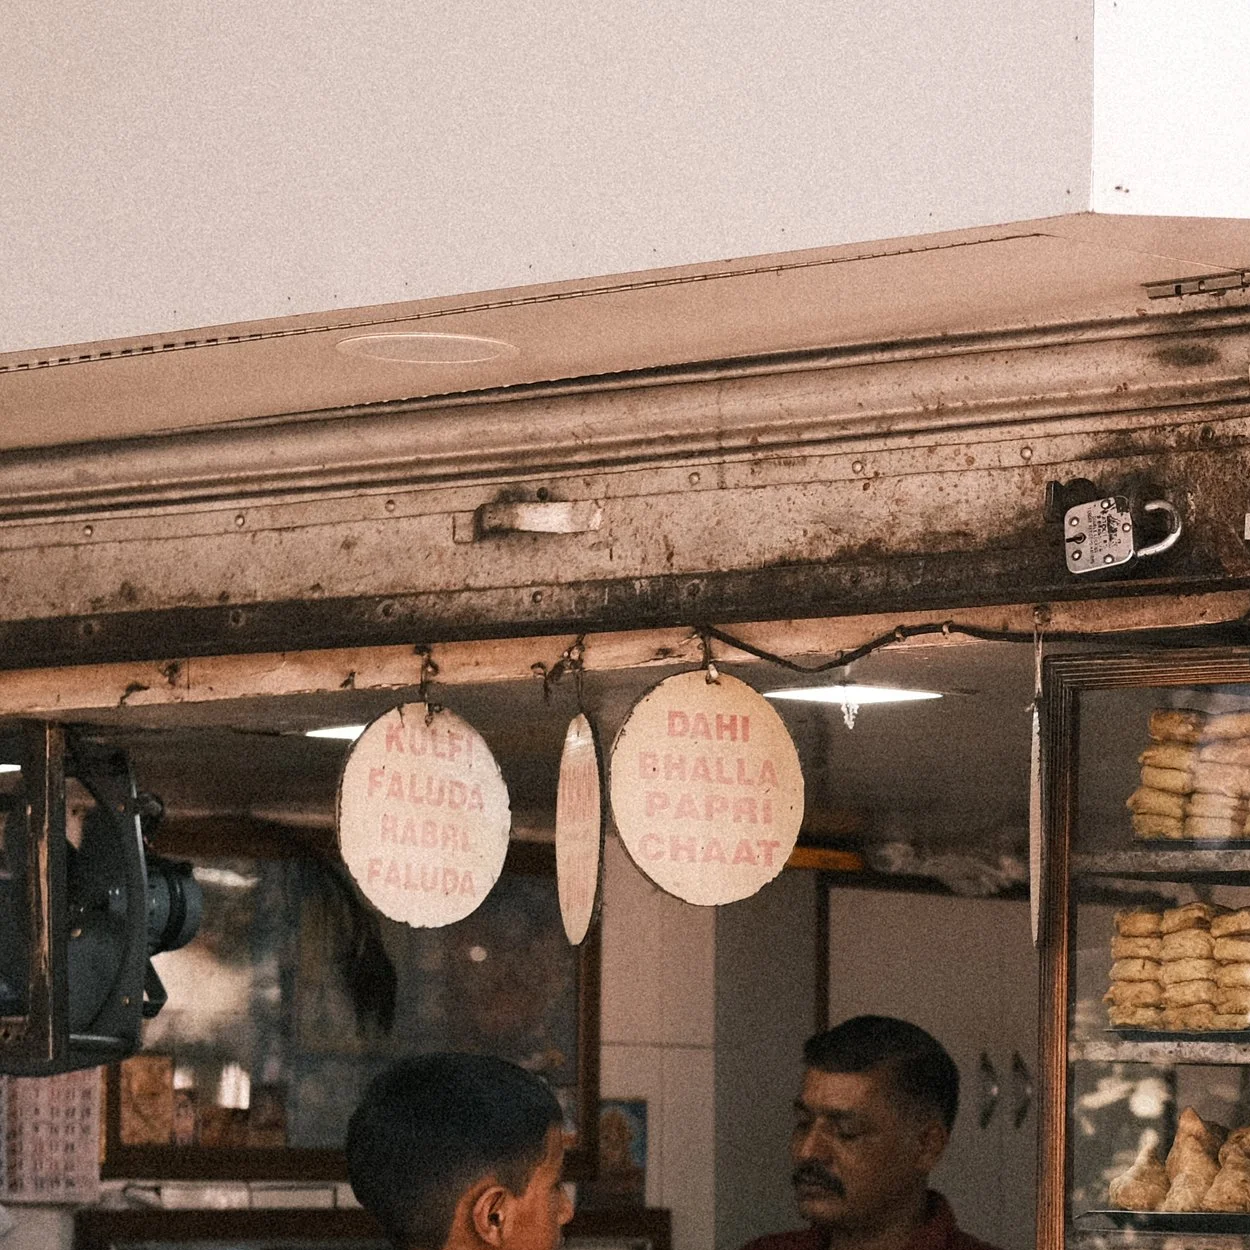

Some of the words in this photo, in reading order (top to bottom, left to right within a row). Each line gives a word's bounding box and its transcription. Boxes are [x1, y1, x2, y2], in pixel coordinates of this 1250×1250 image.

[667, 709, 750, 742] DAHI
[638, 752, 780, 788] BHALLA
[367, 767, 486, 814] FALUDA
[645, 790, 774, 826] PAPRI
[638, 832, 781, 869] CHAAT
[367, 857, 477, 899] FALUDA
